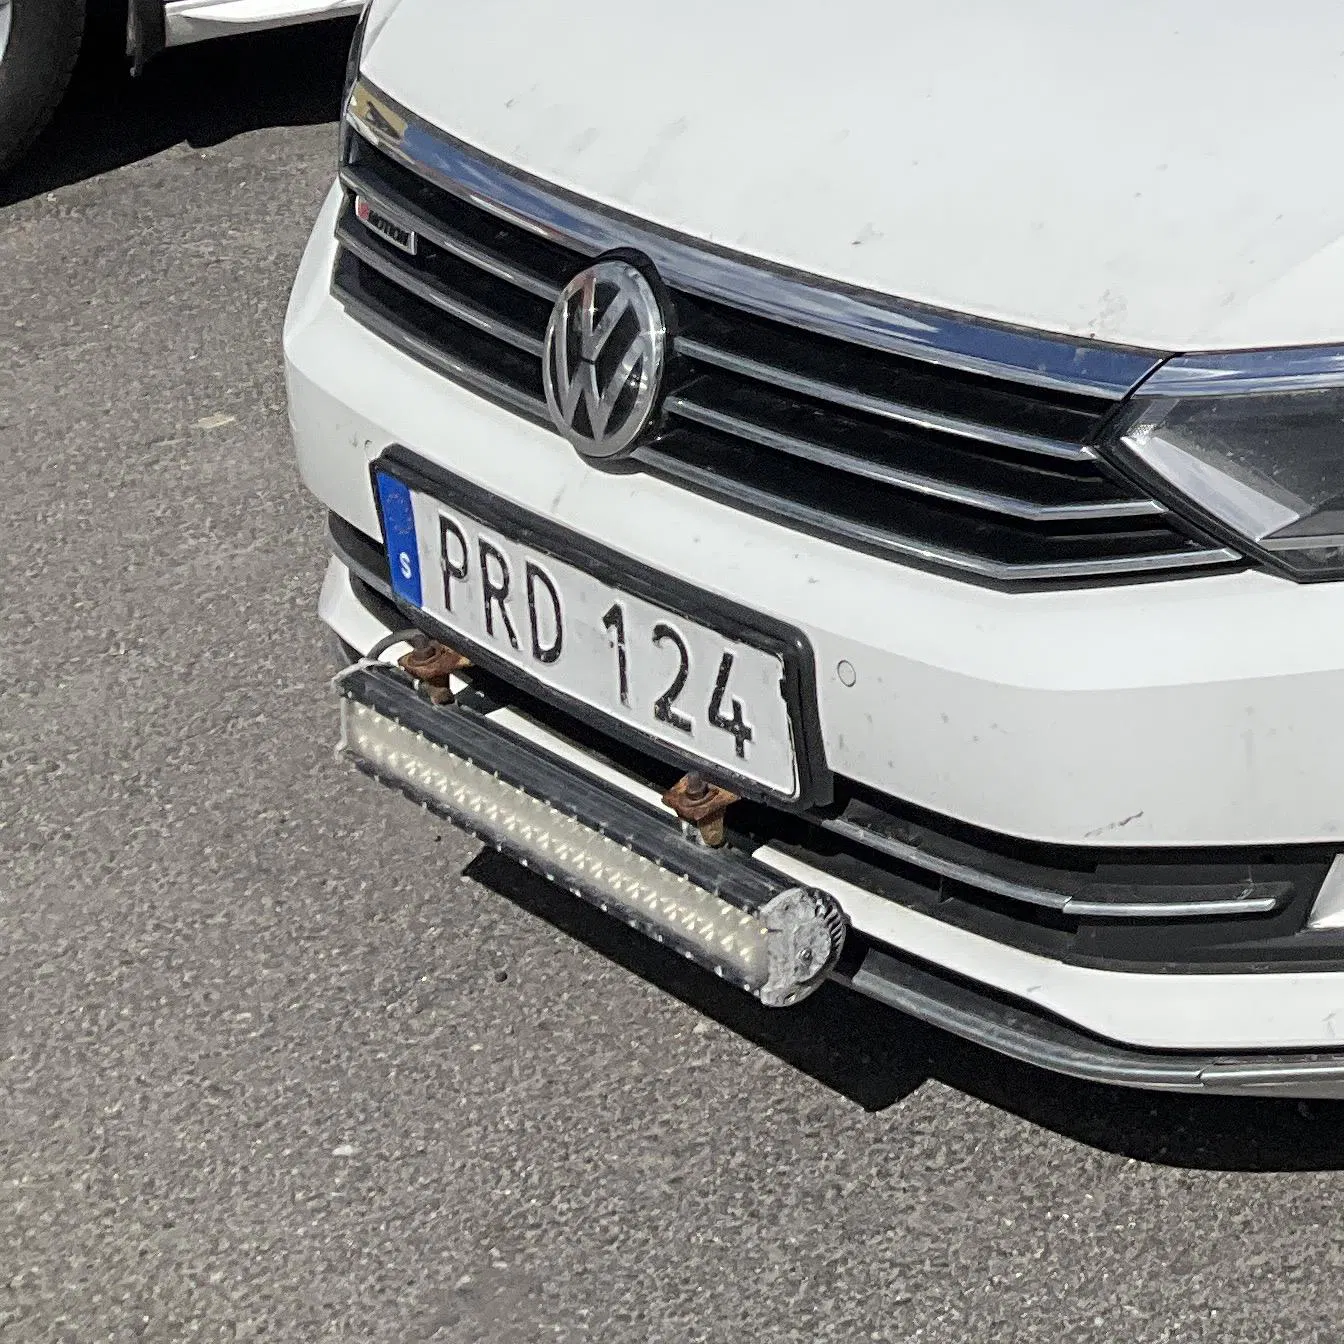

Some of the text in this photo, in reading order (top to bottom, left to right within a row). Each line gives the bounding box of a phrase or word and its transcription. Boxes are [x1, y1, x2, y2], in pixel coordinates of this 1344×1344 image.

[398, 551, 412, 580] S
[438, 515, 754, 759] PRD 124
